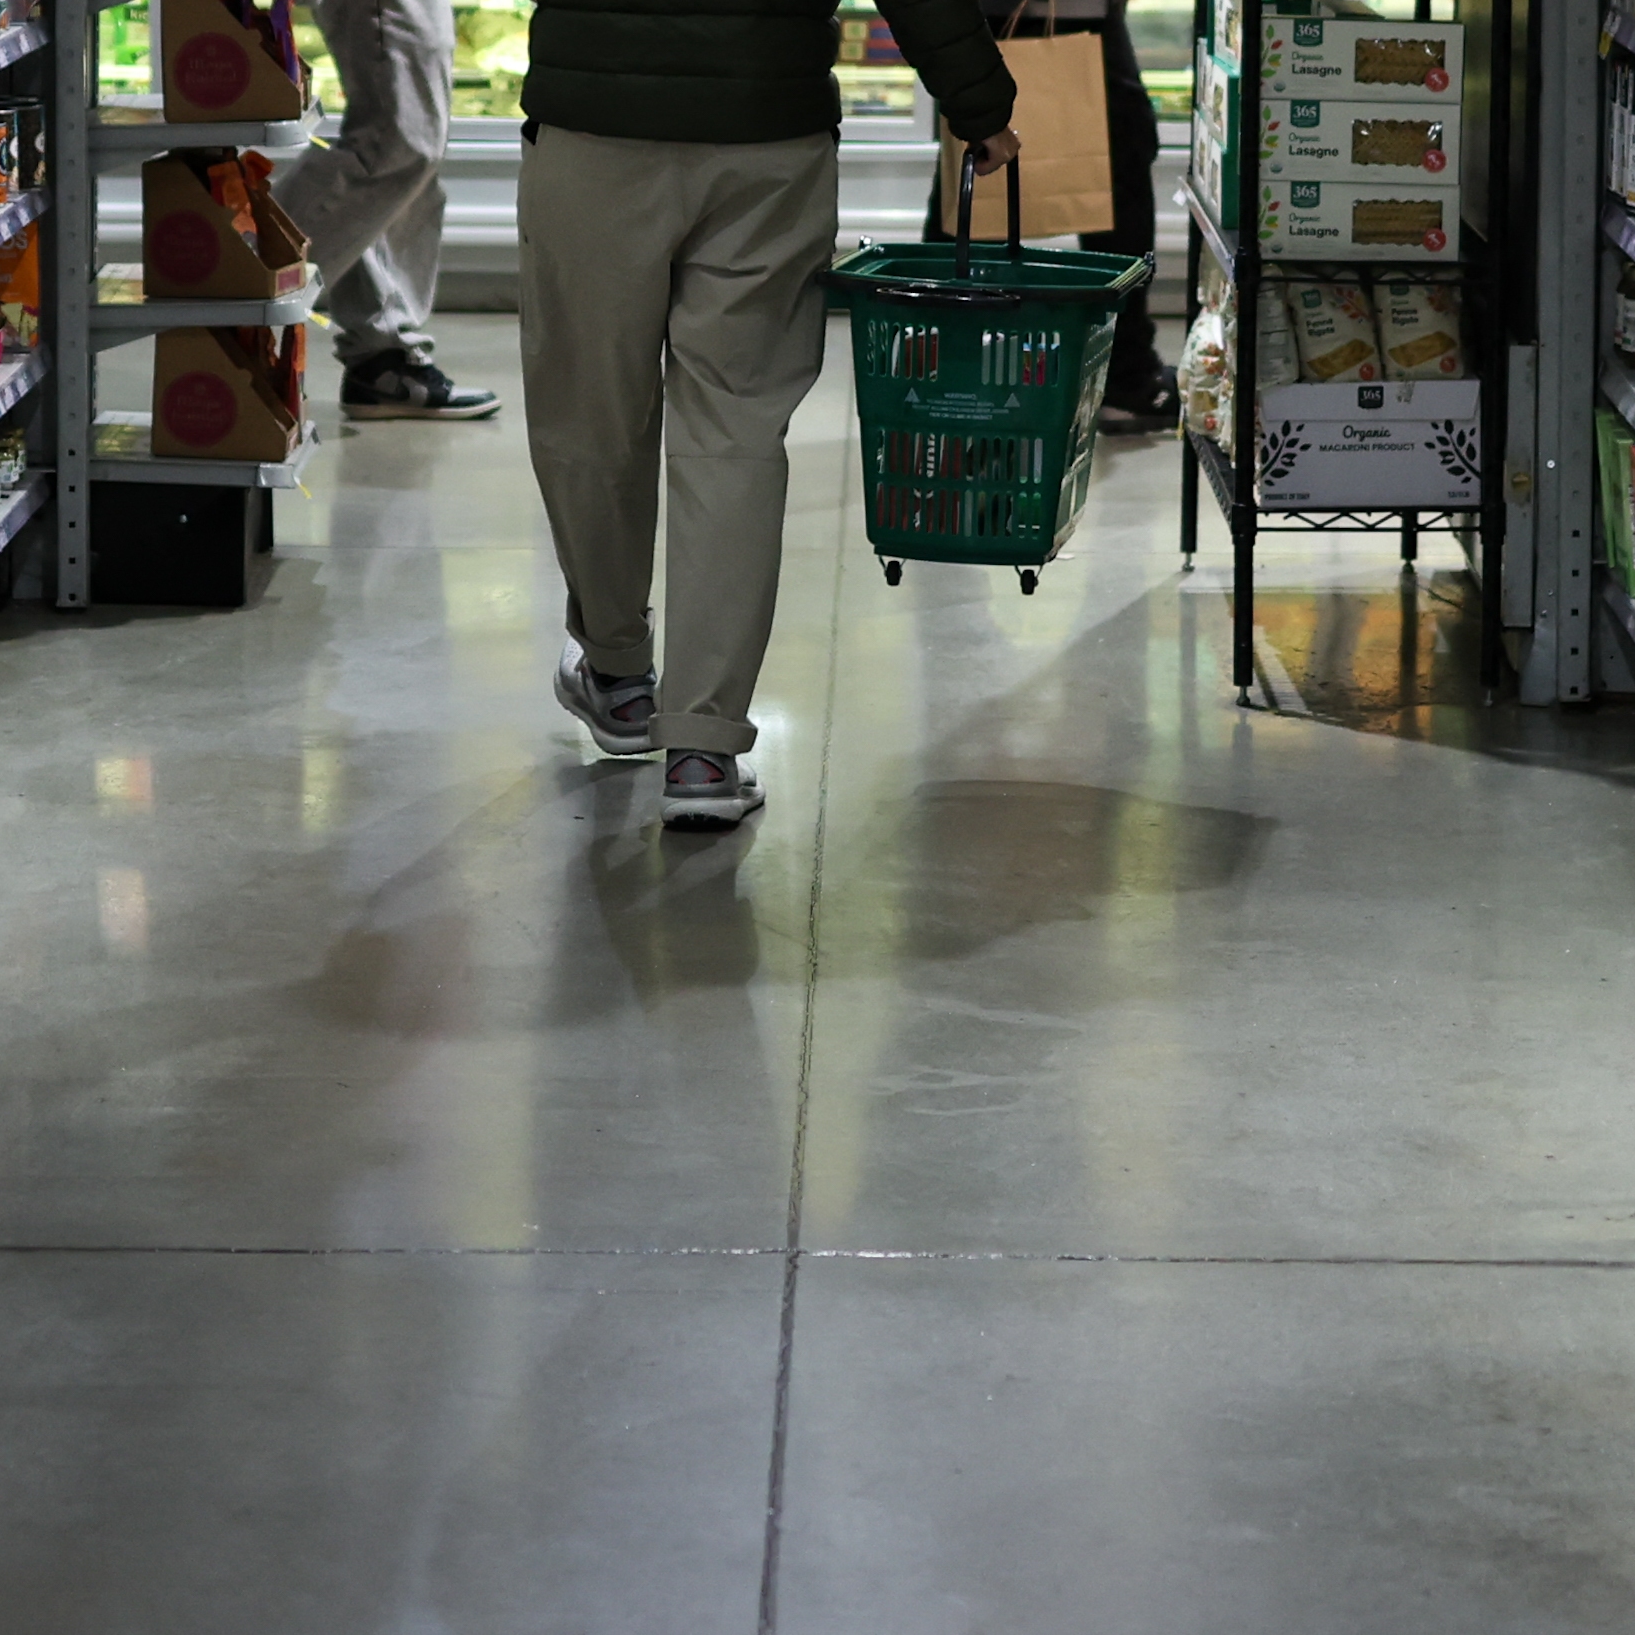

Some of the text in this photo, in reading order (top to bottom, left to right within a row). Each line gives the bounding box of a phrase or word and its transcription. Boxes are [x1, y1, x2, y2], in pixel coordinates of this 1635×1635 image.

[1296, 25, 1320, 37] 365
[1291, 63, 1342, 77] Lasagne
[1293, 106, 1317, 117] 365
[1288, 145, 1339, 159] Lasagne
[1292, 186, 1318, 198] 365
[1288, 225, 1340, 239] Lasagne
[1360, 391, 1382, 402] 365
[1342, 425, 1392, 442] Organic
[1319, 442, 1415, 452] MACARONI PRODUCT
